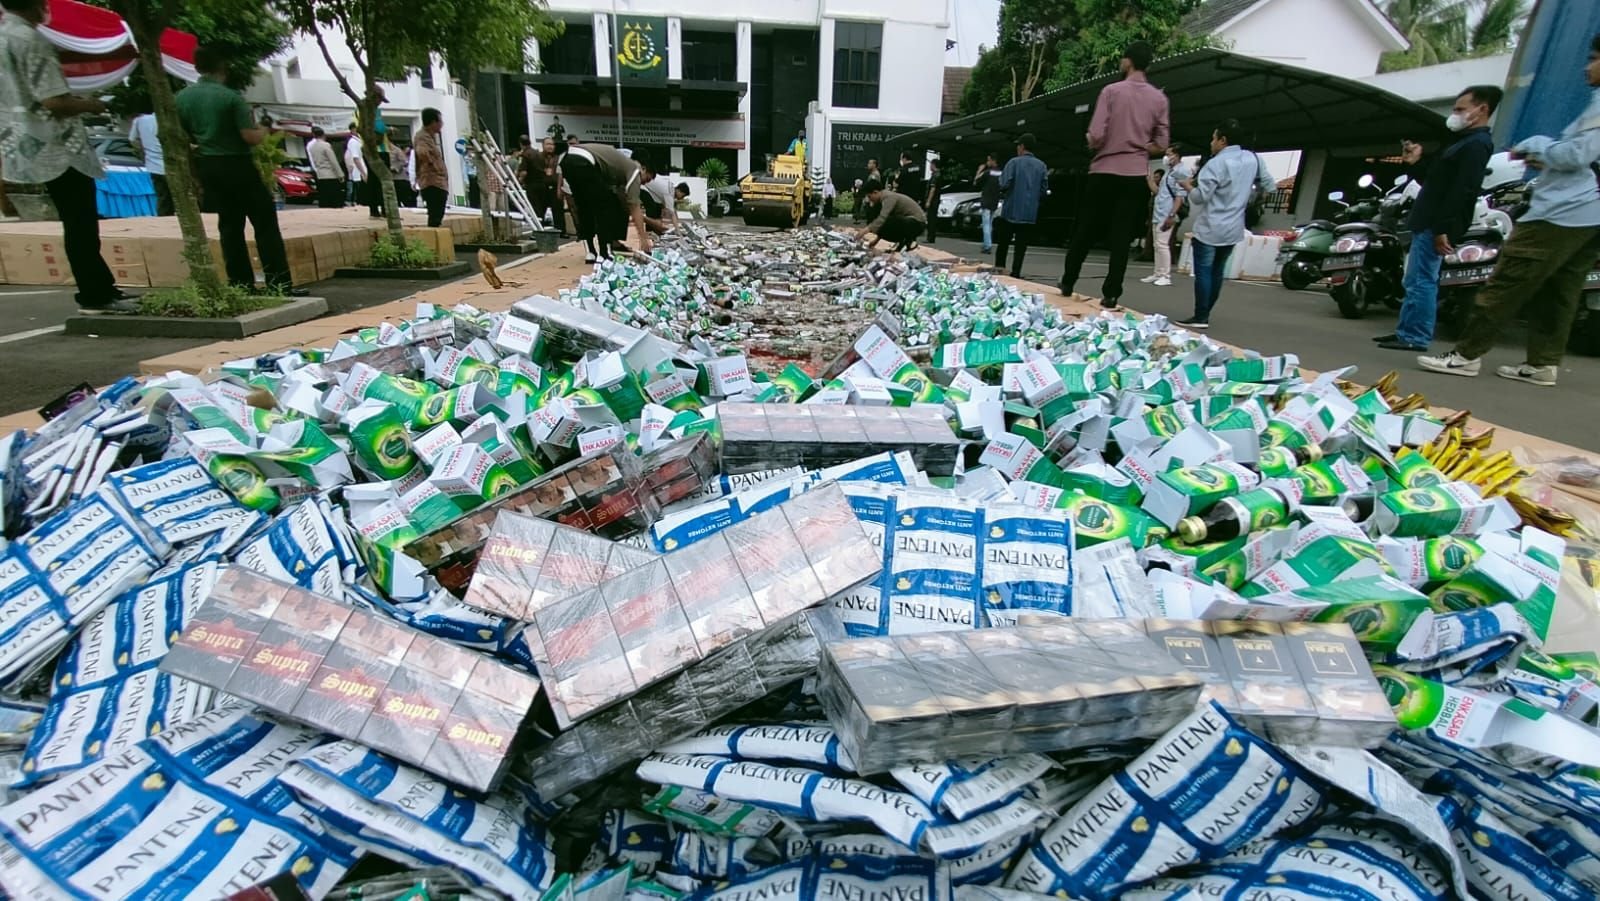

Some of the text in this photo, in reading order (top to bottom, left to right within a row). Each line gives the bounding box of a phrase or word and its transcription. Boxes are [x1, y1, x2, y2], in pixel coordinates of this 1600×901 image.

[837, 132, 851, 141] TRI
[852, 132, 882, 141] KRAMA
[720, 369, 746, 380] ENKASARI
[653, 382, 682, 398] ENKASARI
[423, 431, 454, 452] ENKASARI
[582, 438, 617, 452] ENKASARI
[470, 453, 488, 485] ENKASARI
[1012, 448, 1036, 479] ENKASARI
[1019, 457, 1037, 480] HERBAL
[1126, 457, 1151, 484] ENKASARI
[130, 470, 202, 497] PANTENE
[150, 491, 225, 520] PANTENE
[596, 498, 629, 521] Supra
[36, 506, 104, 556] PANTENE
[170, 510, 246, 534] PANTENE
[298, 504, 323, 555] PANTENE
[361, 511, 402, 536] ENKASARI
[370, 520, 401, 540] HERBAL
[687, 519, 732, 537] ANTI KETOMBE
[55, 530, 125, 582] PANTENE
[490, 544, 537, 559] Supra
[897, 536, 973, 558] PANTENE
[989, 549, 1065, 568] PANTENE
[244, 546, 267, 577] PANT
[71, 550, 141, 608] PANTENE
[190, 568, 203, 615] PANTE
[1266, 570, 1289, 591] ENKAS
[138, 588, 155, 657] PANTENE
[894, 601, 971, 624] PANTENE
[83, 611, 104, 679] PANTENE
[189, 626, 244, 651] Supra
[253, 648, 310, 673] Supra
[320, 673, 377, 699] Supra
[112, 674, 146, 748] PANTENE
[385, 695, 441, 720] Supra
[1436, 698, 1458, 728] HERBAL
[1447, 697, 1474, 737] ENKASARI
[42, 694, 91, 763] PANTENE
[449, 723, 503, 747] Supra
[745, 727, 827, 743] PANTENE
[192, 752, 210, 765] ANTI
[227, 732, 315, 789] PANTENE
[1135, 713, 1222, 788] PANTENE
[725, 762, 803, 783] PANTENE
[16, 750, 144, 834] PANTENE
[1170, 766, 1219, 809] ANTI KETOMBE
[1203, 766, 1275, 840] PANTENE
[1049, 788, 1129, 861] PANTENE
[94, 799, 214, 893] PANTENE
[218, 835, 290, 898] TENE
[1085, 845, 1129, 888] ANTI KETOMBE
[1510, 854, 1552, 886] KETOMBE
